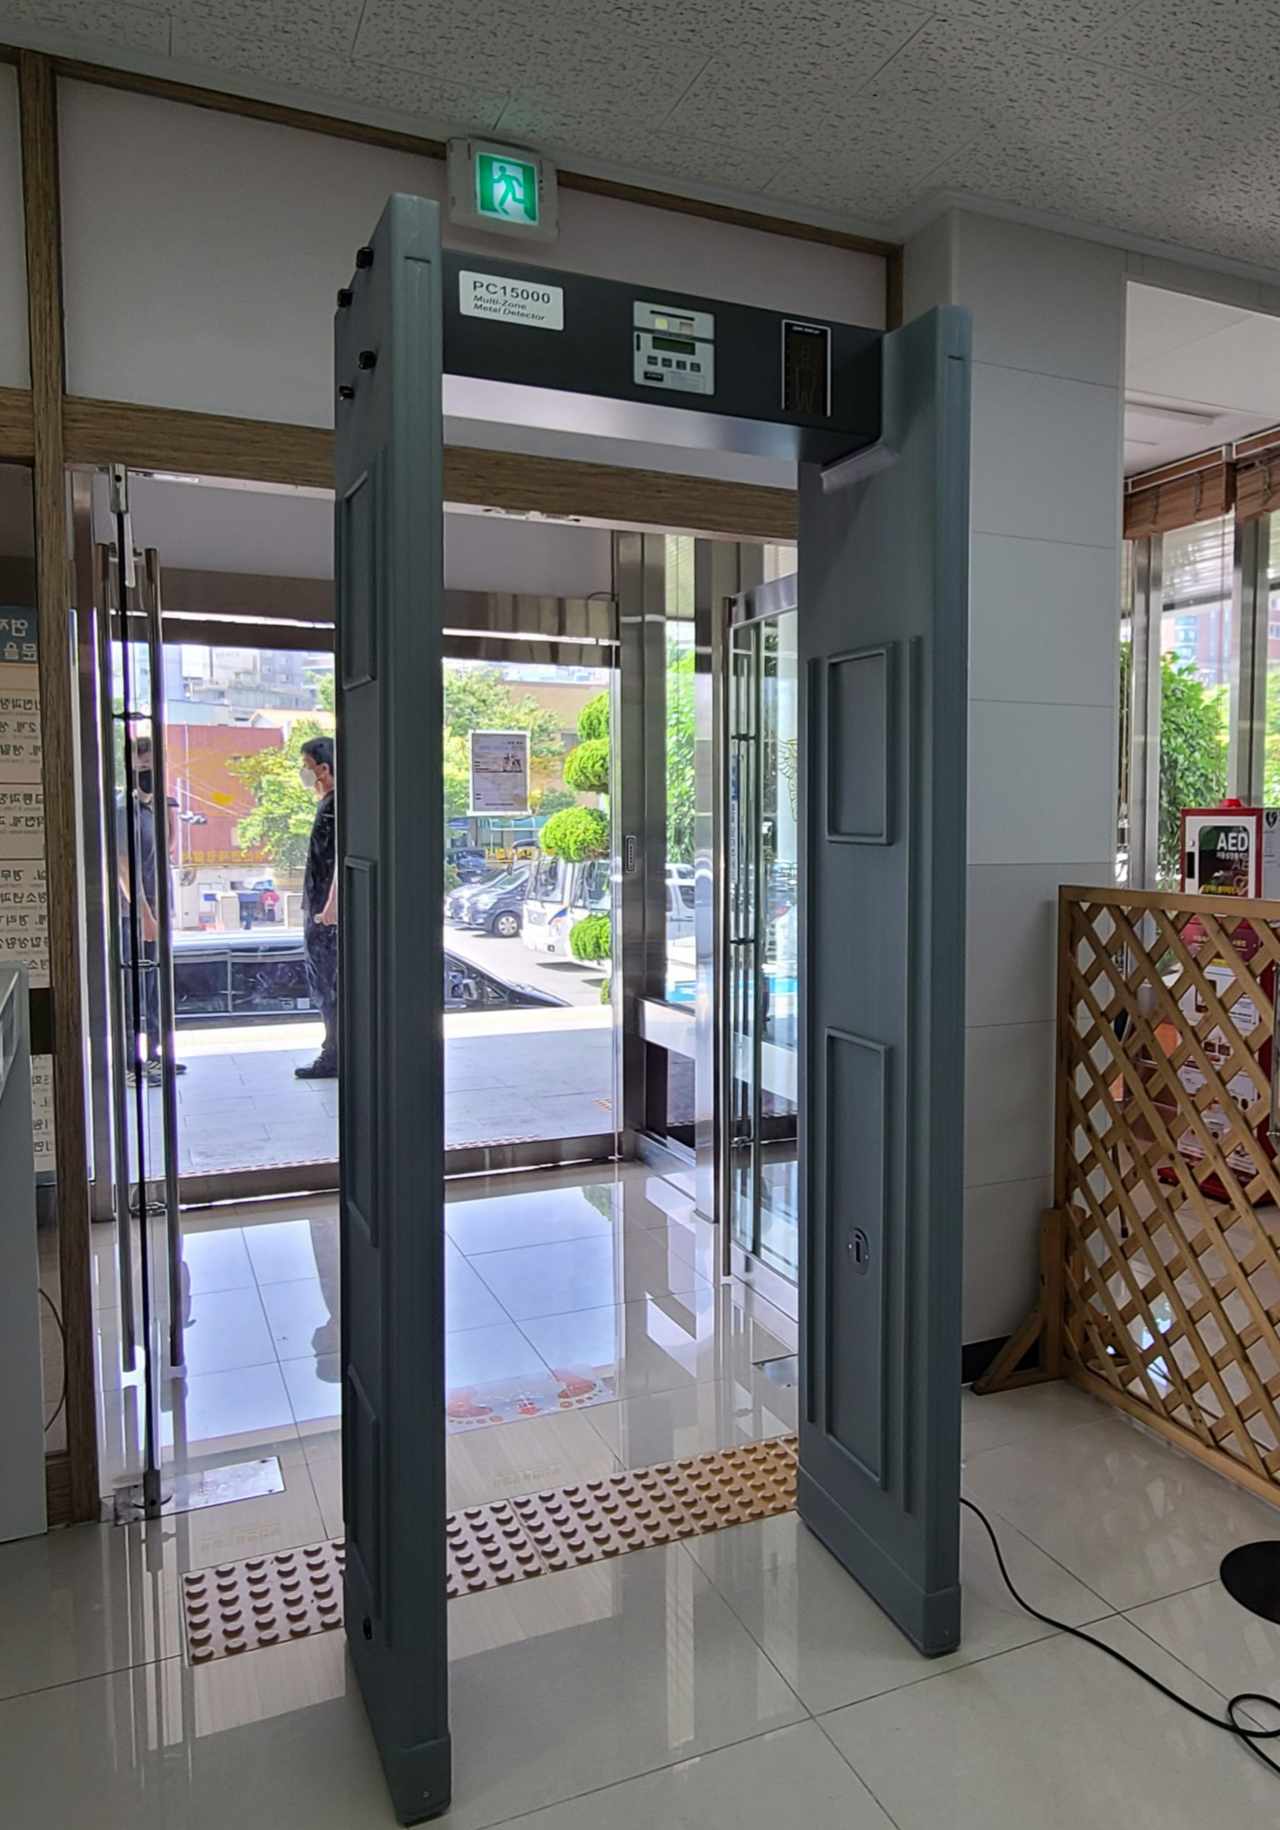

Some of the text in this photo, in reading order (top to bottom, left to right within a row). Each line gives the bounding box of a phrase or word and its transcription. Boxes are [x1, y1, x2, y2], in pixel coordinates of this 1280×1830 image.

[473, 280, 551, 305] PC15000
[473, 294, 527, 310] Multi-Zone
[473, 303, 546, 321] Metal Detector
[1216, 831, 1249, 852] AED
